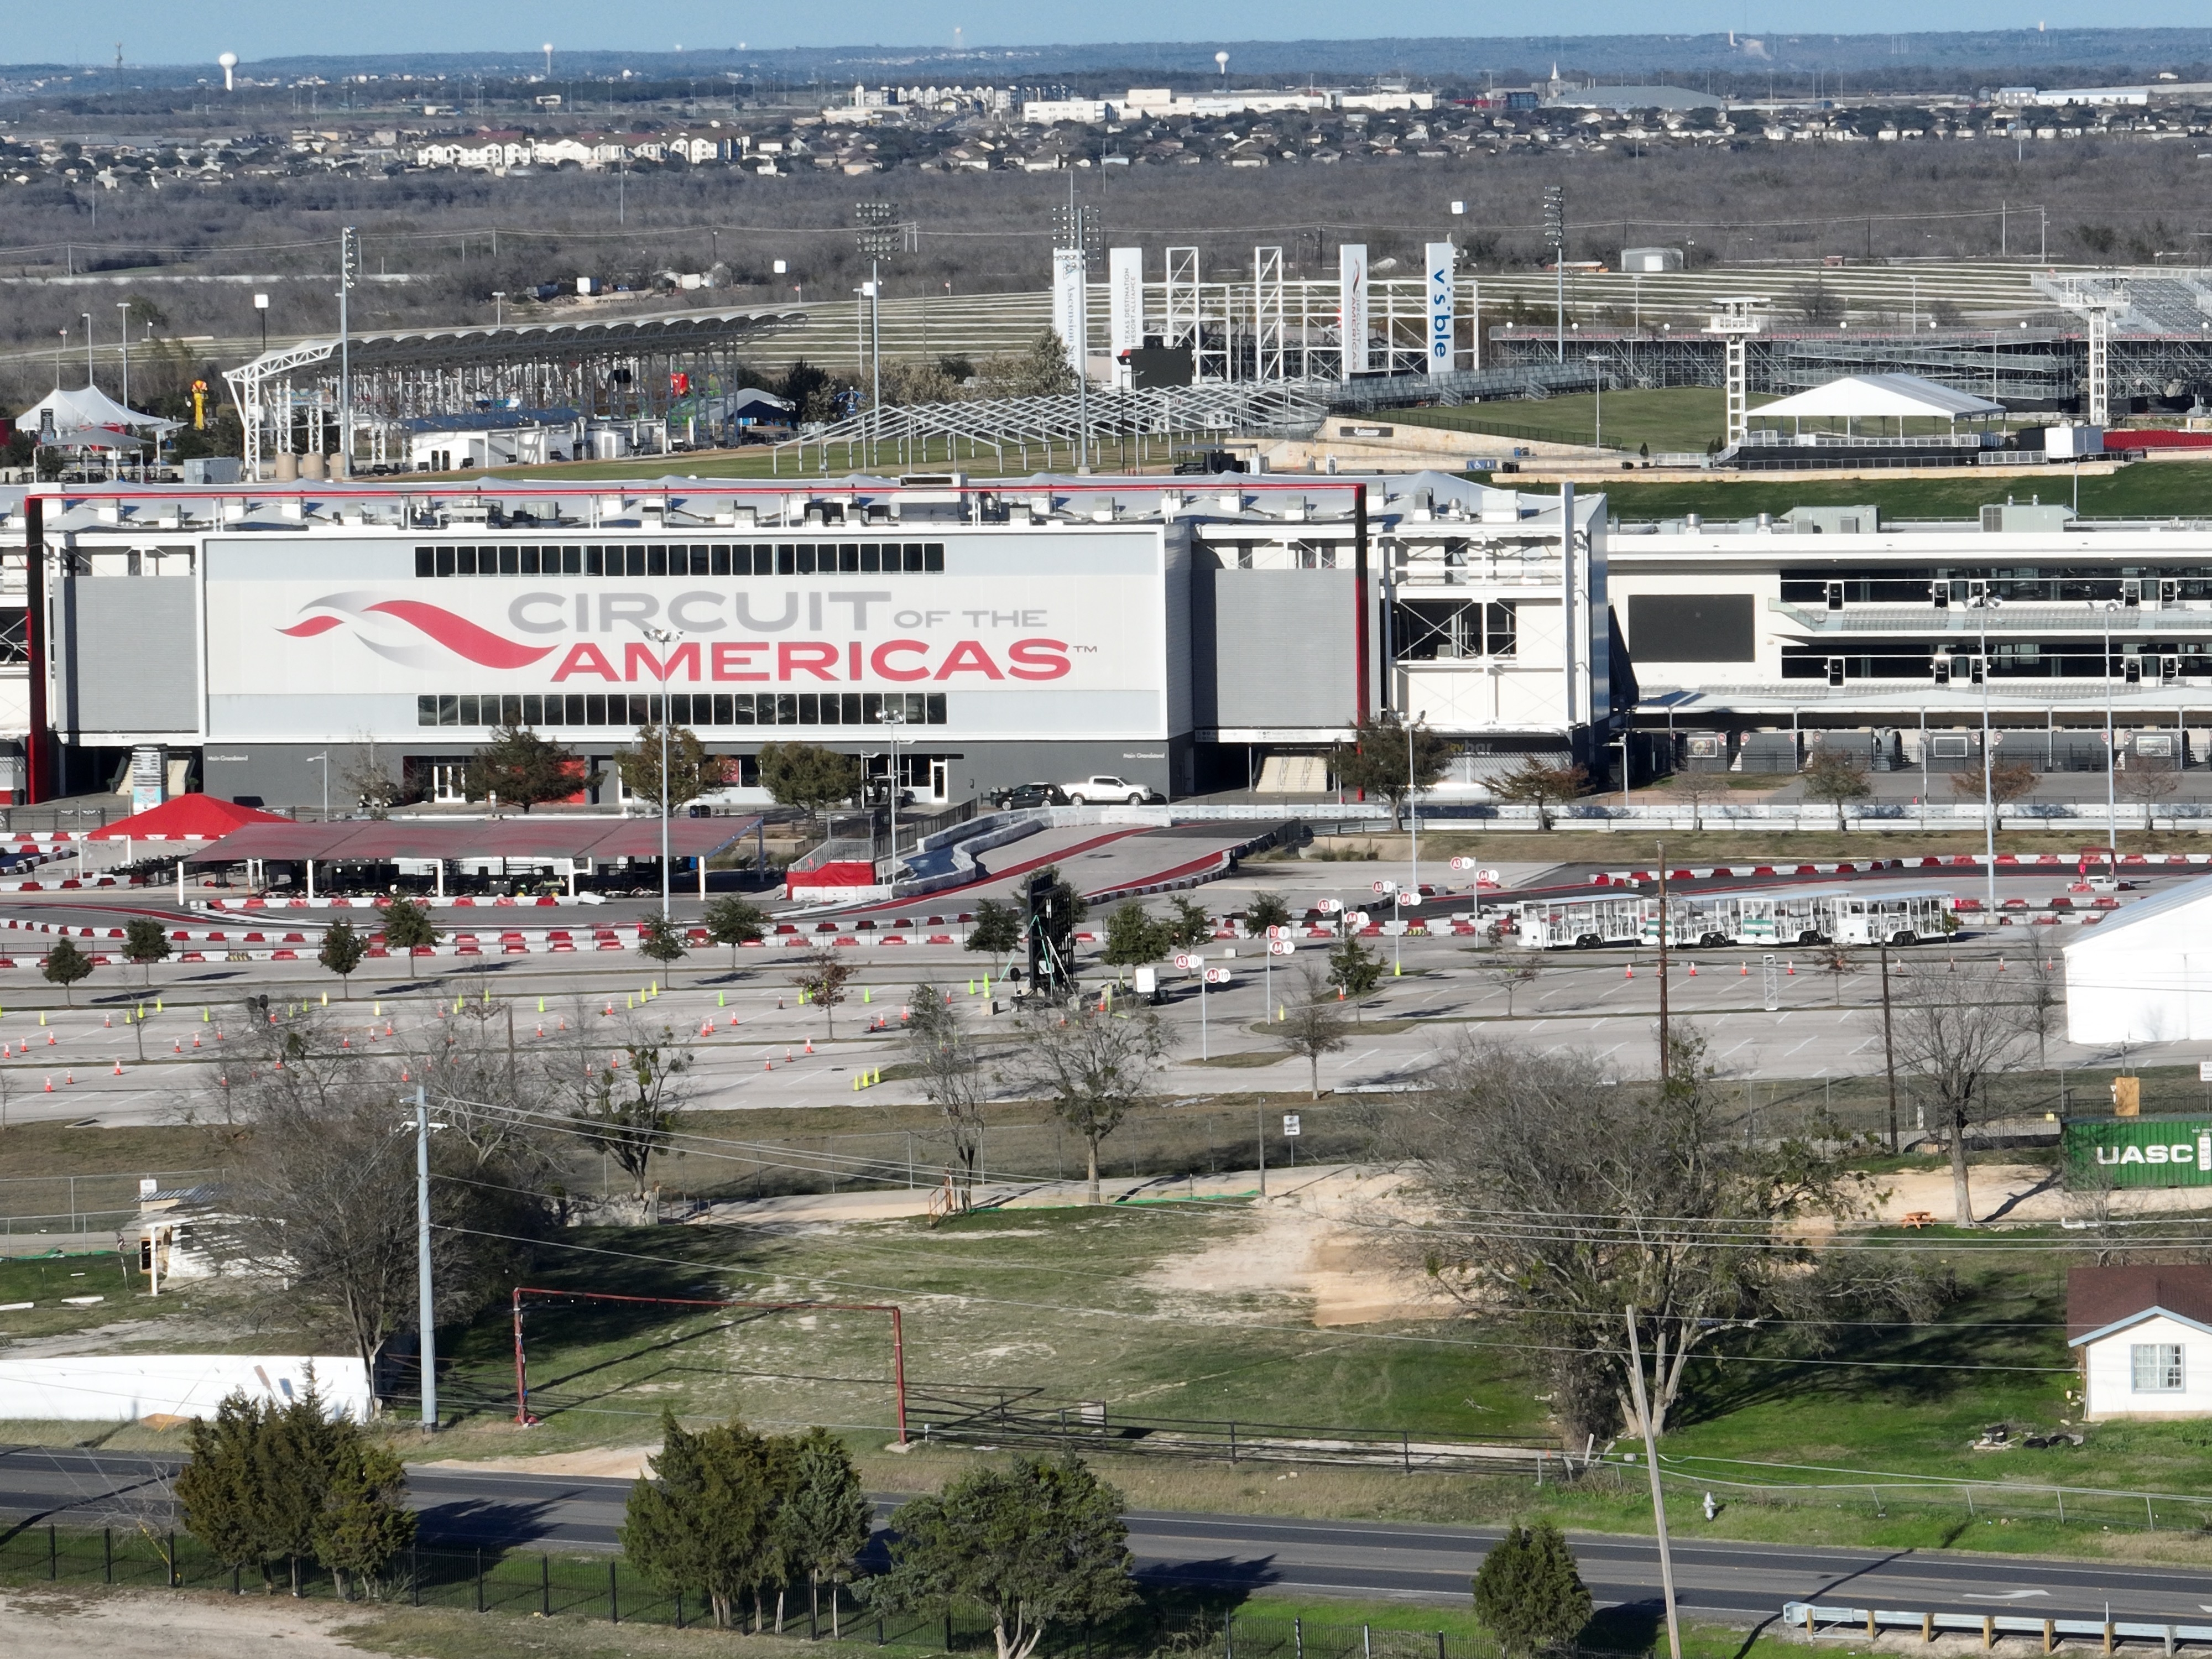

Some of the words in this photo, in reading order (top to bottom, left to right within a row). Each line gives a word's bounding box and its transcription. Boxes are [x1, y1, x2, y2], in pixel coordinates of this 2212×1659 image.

[1067, 283, 1077, 342] Ascension
[507, 591, 891, 633] CIRCUIT
[894, 610, 950, 628] OF
[962, 609, 1048, 628] THE
[550, 639, 1072, 682] AMERICAS
[2096, 1144, 2194, 1165] UASC
